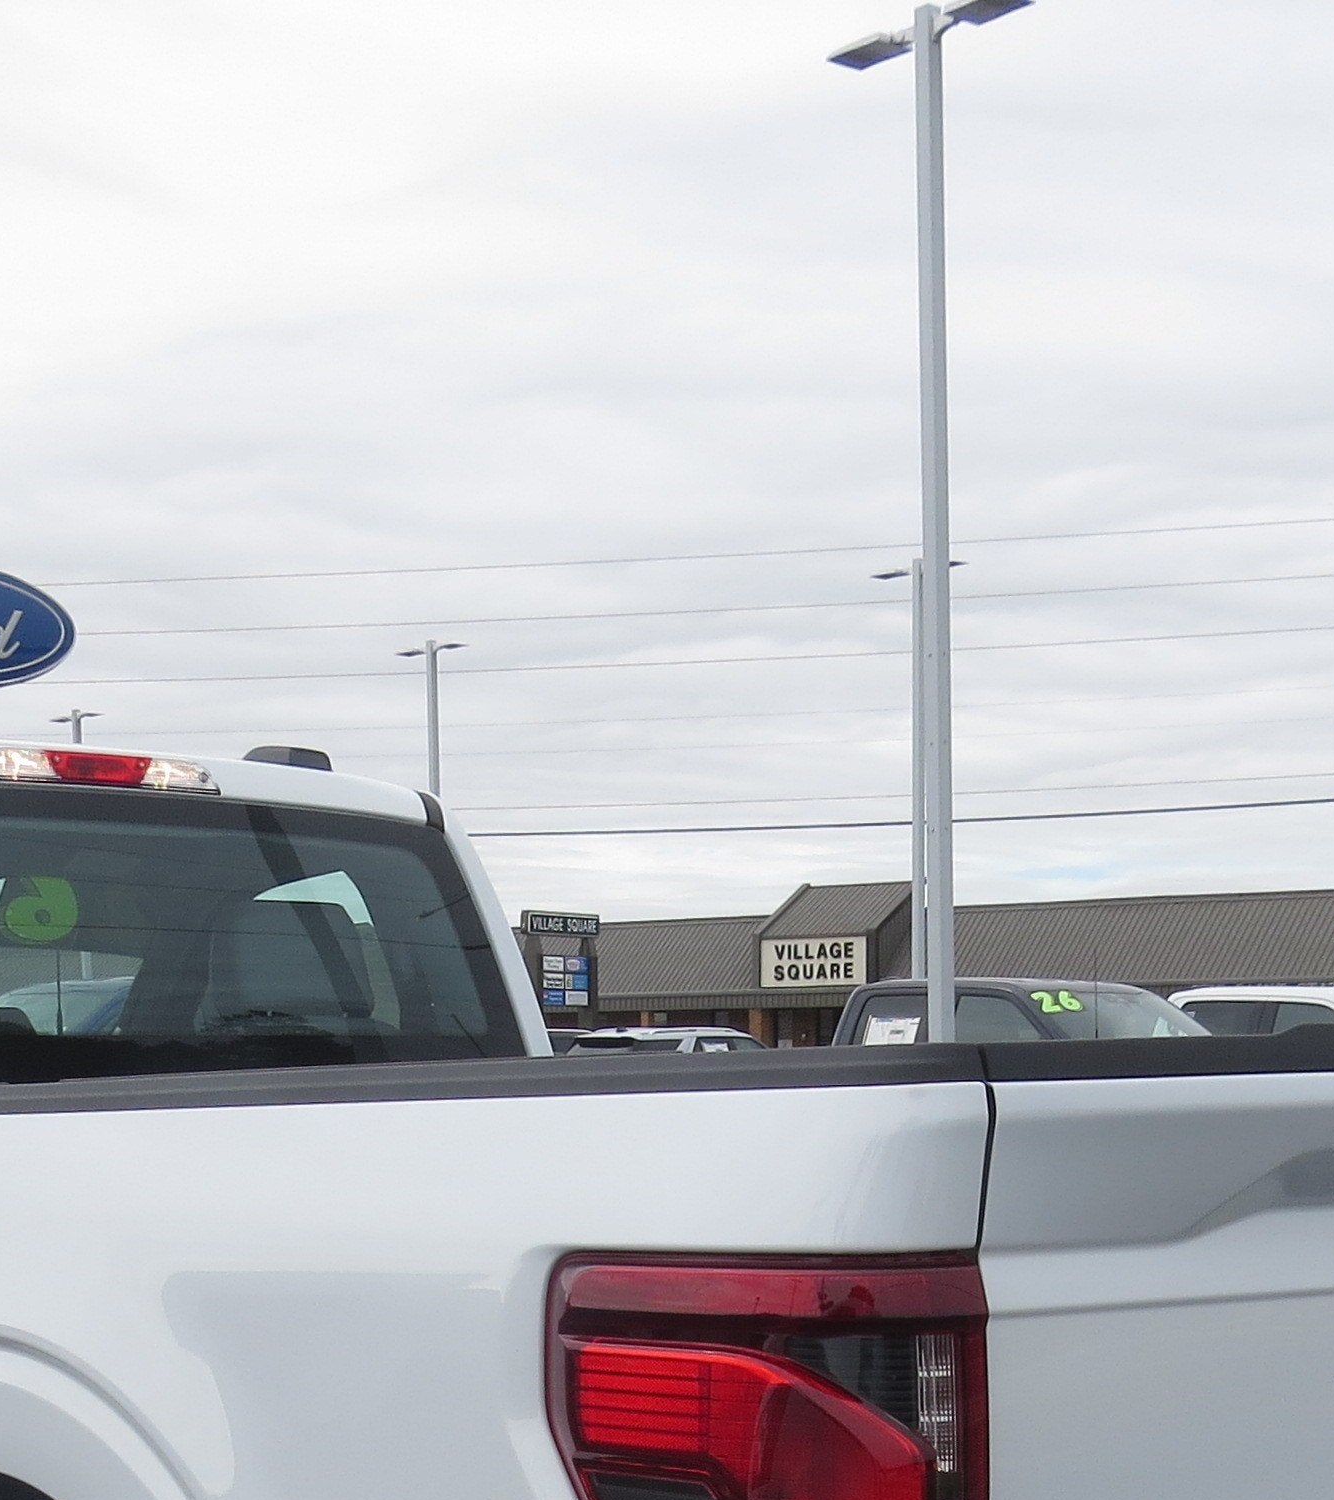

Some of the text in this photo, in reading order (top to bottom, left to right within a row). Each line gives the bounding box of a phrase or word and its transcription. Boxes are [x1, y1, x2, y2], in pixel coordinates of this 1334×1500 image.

[532, 916, 597, 933] VILLAGE SQUARE
[774, 942, 854, 960] VILLAGE
[774, 962, 854, 981] SQUARE
[1030, 990, 1084, 1013] 26
